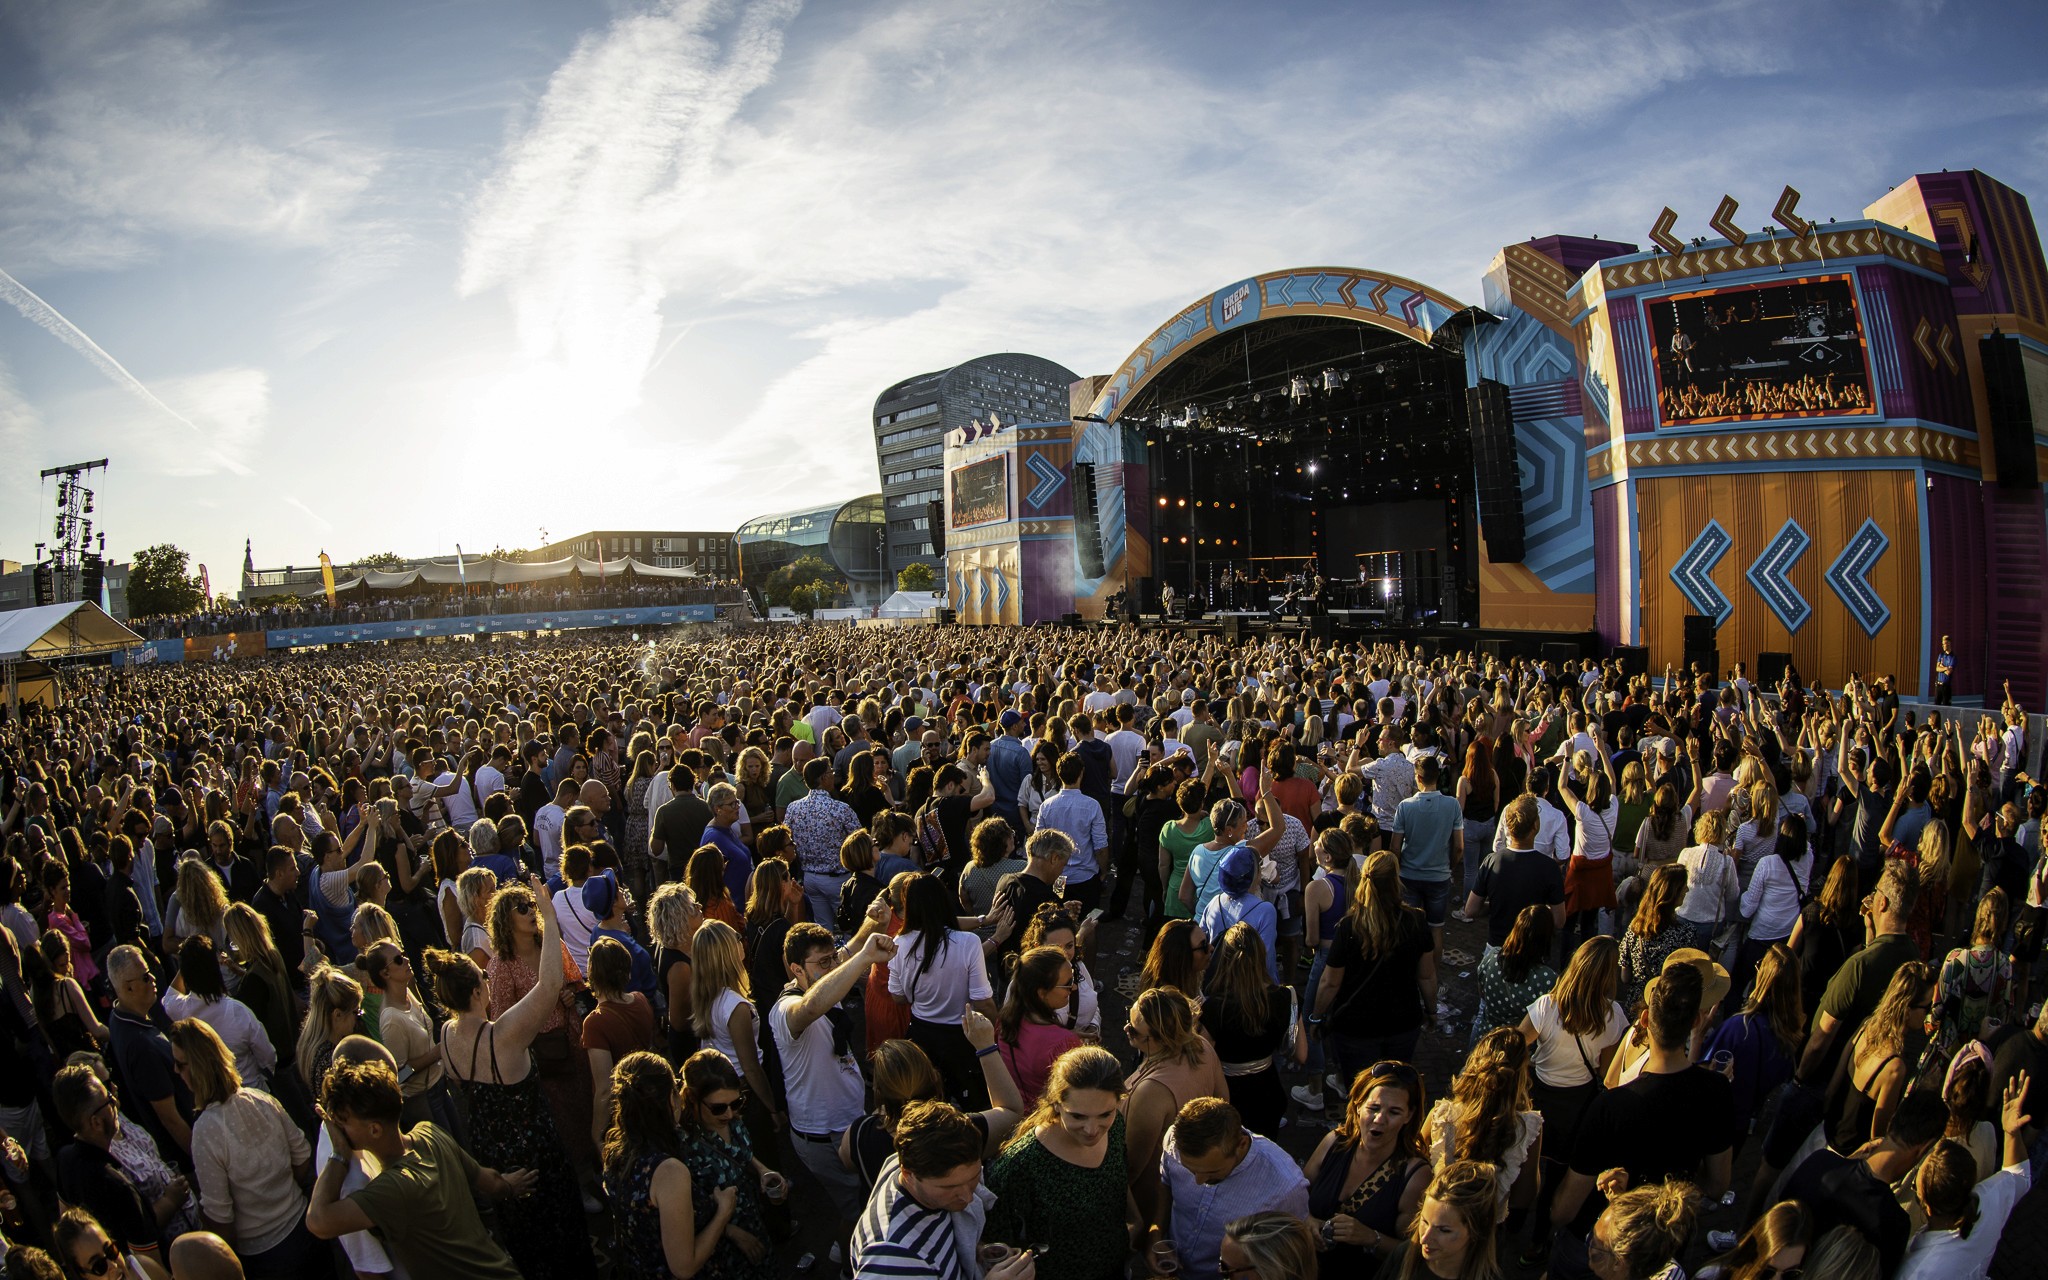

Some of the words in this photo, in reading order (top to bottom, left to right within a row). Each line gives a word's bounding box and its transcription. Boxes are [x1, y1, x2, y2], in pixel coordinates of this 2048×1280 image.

[1224, 284, 1249, 309] BREDA
[1224, 300, 1242, 320] LIVE
[135, 647, 158, 664] BREDA
